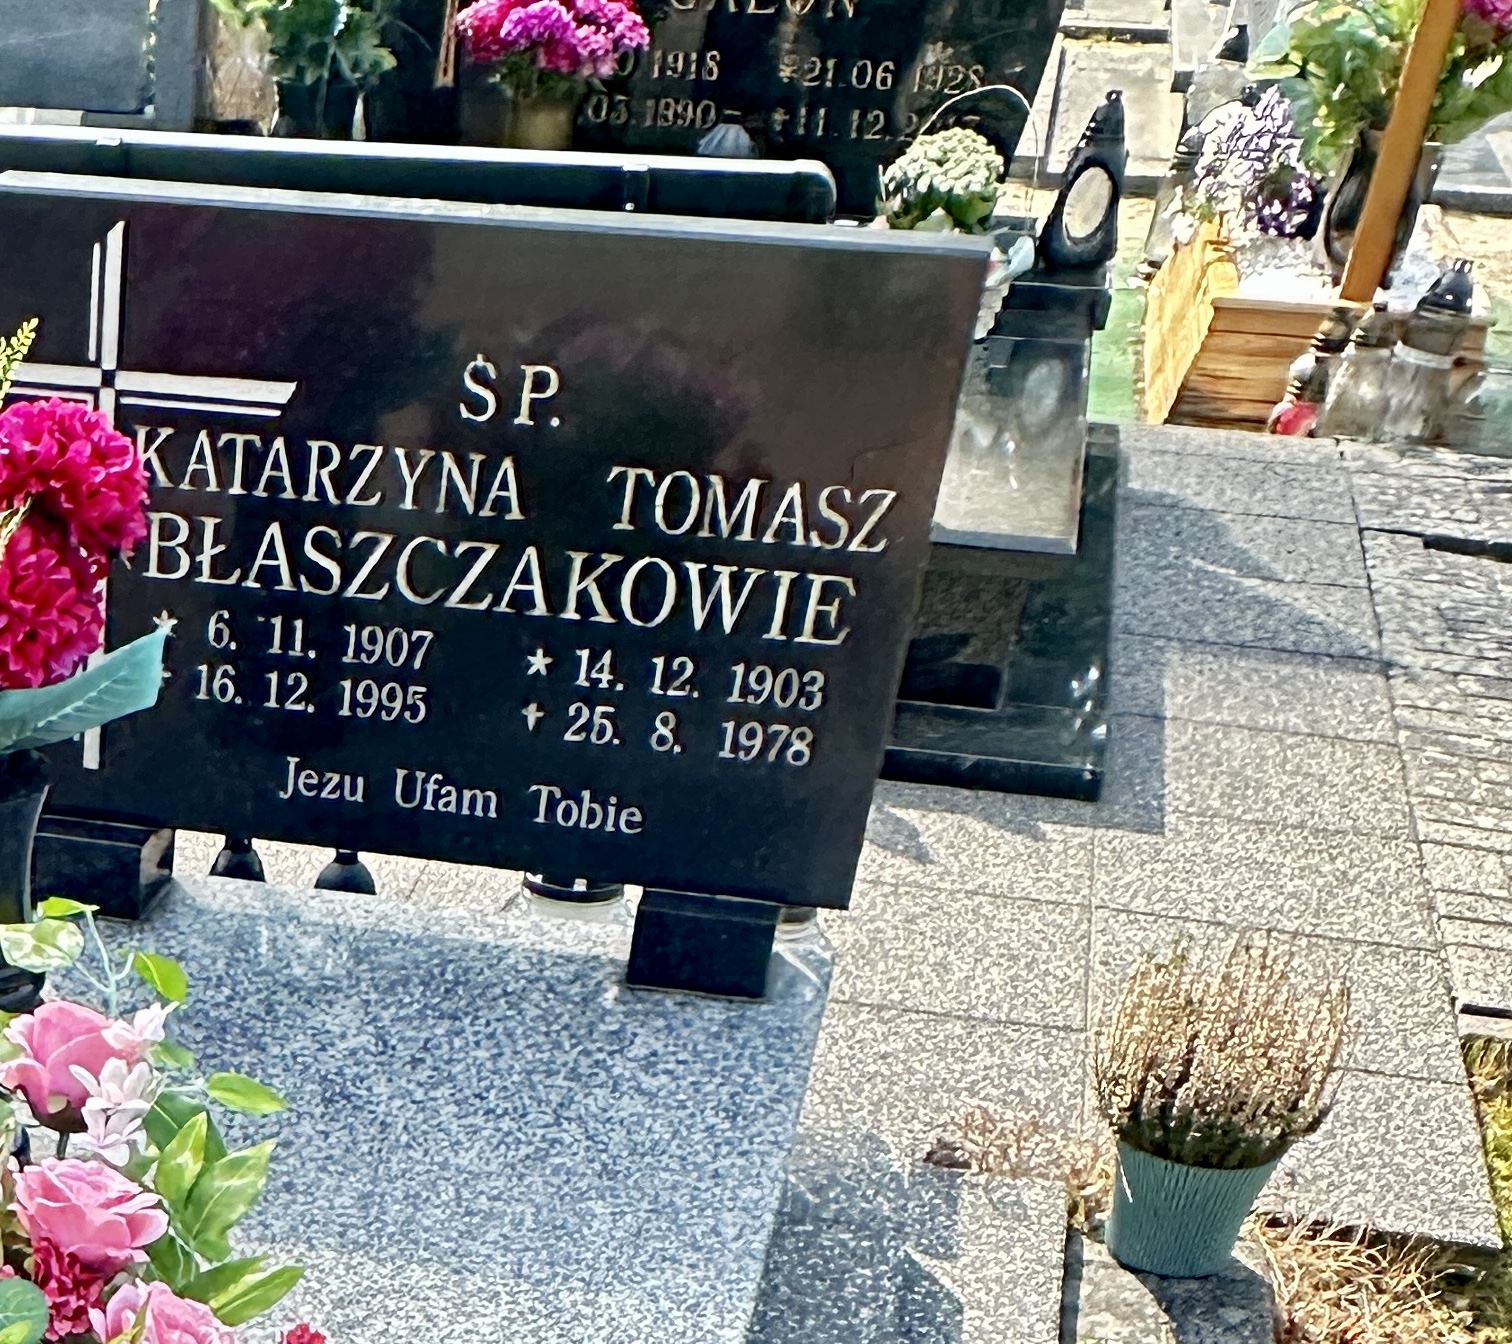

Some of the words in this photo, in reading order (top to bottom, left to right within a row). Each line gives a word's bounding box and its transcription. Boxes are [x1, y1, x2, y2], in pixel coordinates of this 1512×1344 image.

[134, 424, 527, 521] KATARZYNA
[606, 465, 898, 554] TOMASZ
[142, 511, 857, 646] BŁASZCZAKOWIE
[341, 623, 434, 671] 1907
[338, 679, 428, 724] 1995
[726, 661, 826, 712] 1903
[718, 720, 814, 767] 1978
[278, 756, 365, 803] Jezu
[394, 768, 499, 819] Ufam
[528, 784, 644, 835] Tobie
